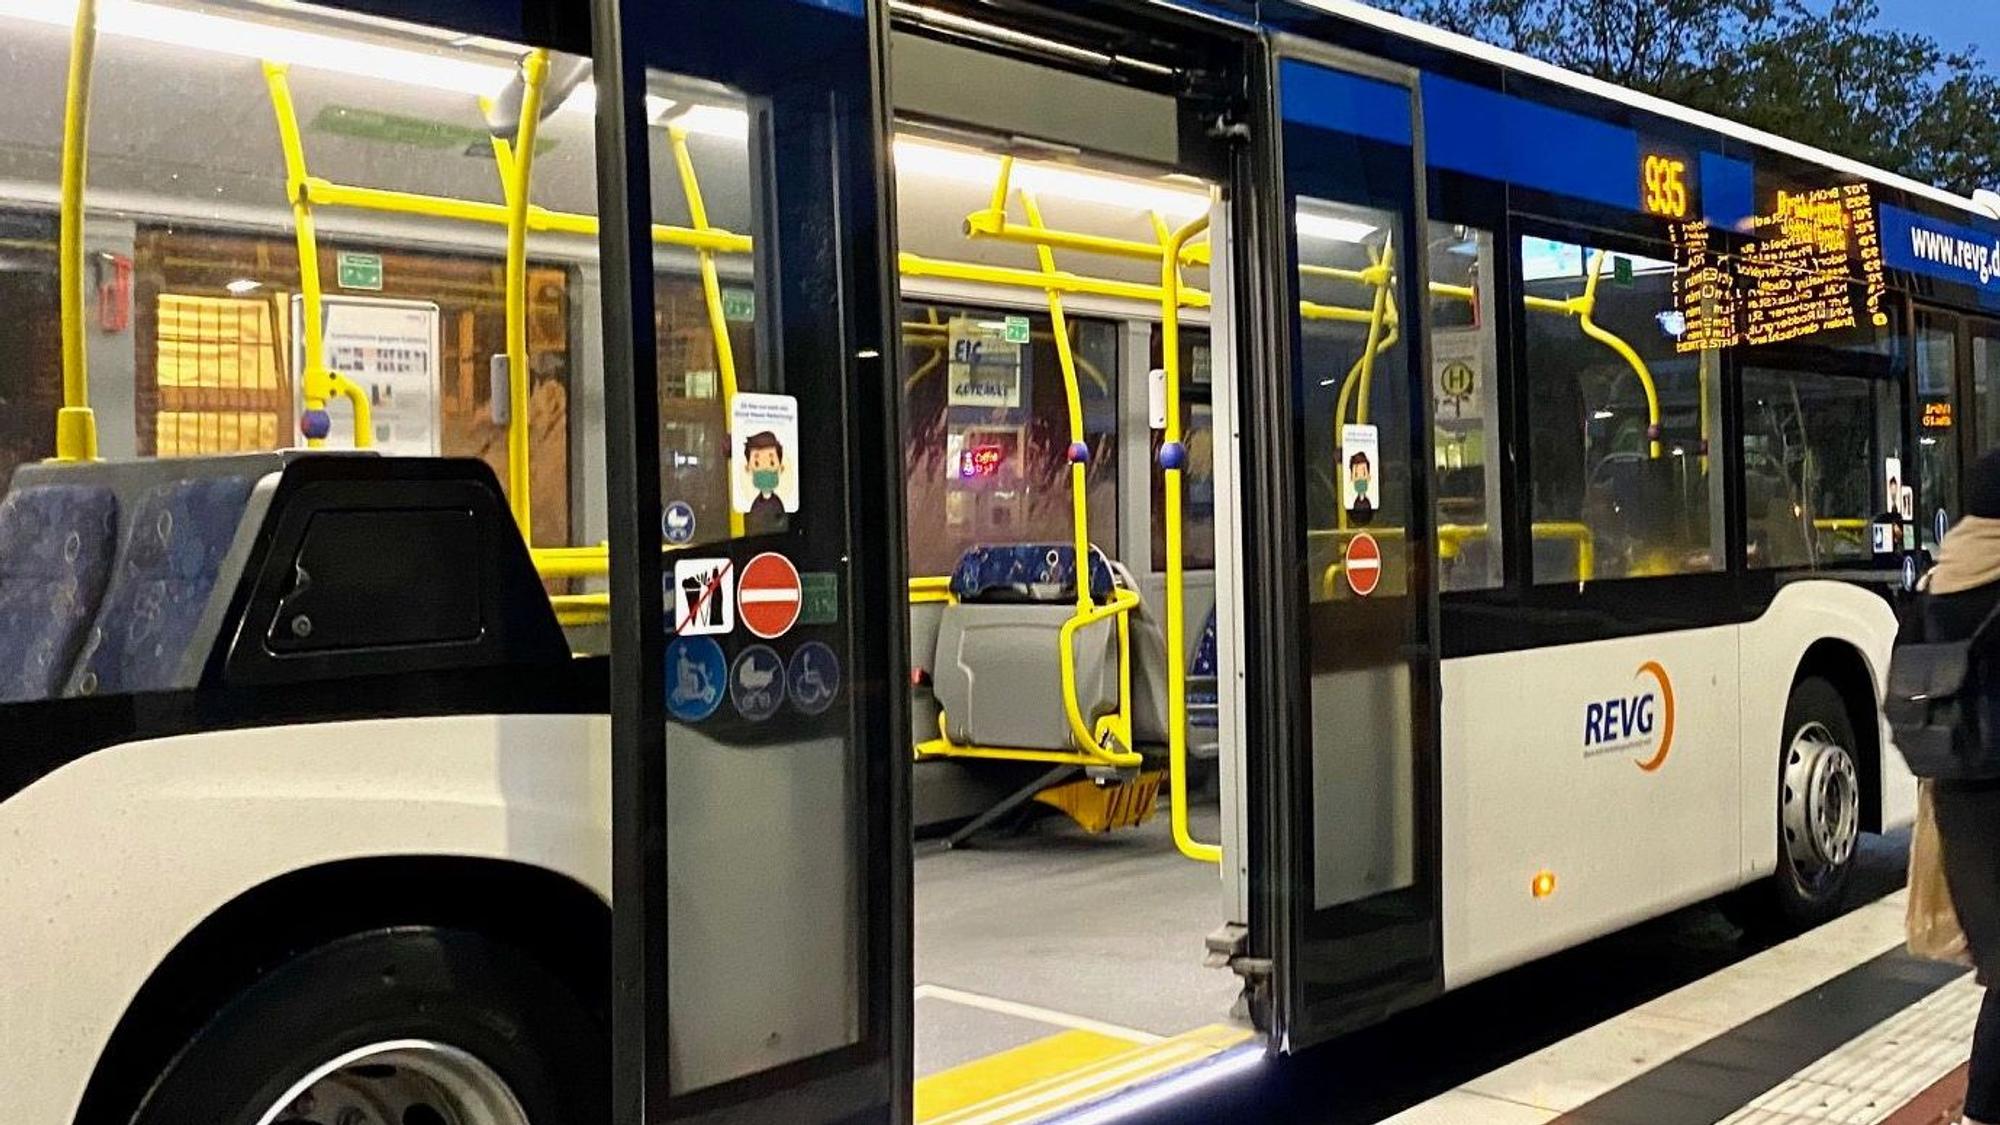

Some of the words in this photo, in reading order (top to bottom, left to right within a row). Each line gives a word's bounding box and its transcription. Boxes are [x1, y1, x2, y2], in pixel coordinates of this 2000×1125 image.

[1645, 155, 1685, 217] 935
[1448, 369, 1465, 389] H
[1584, 693, 1654, 747] REVG
